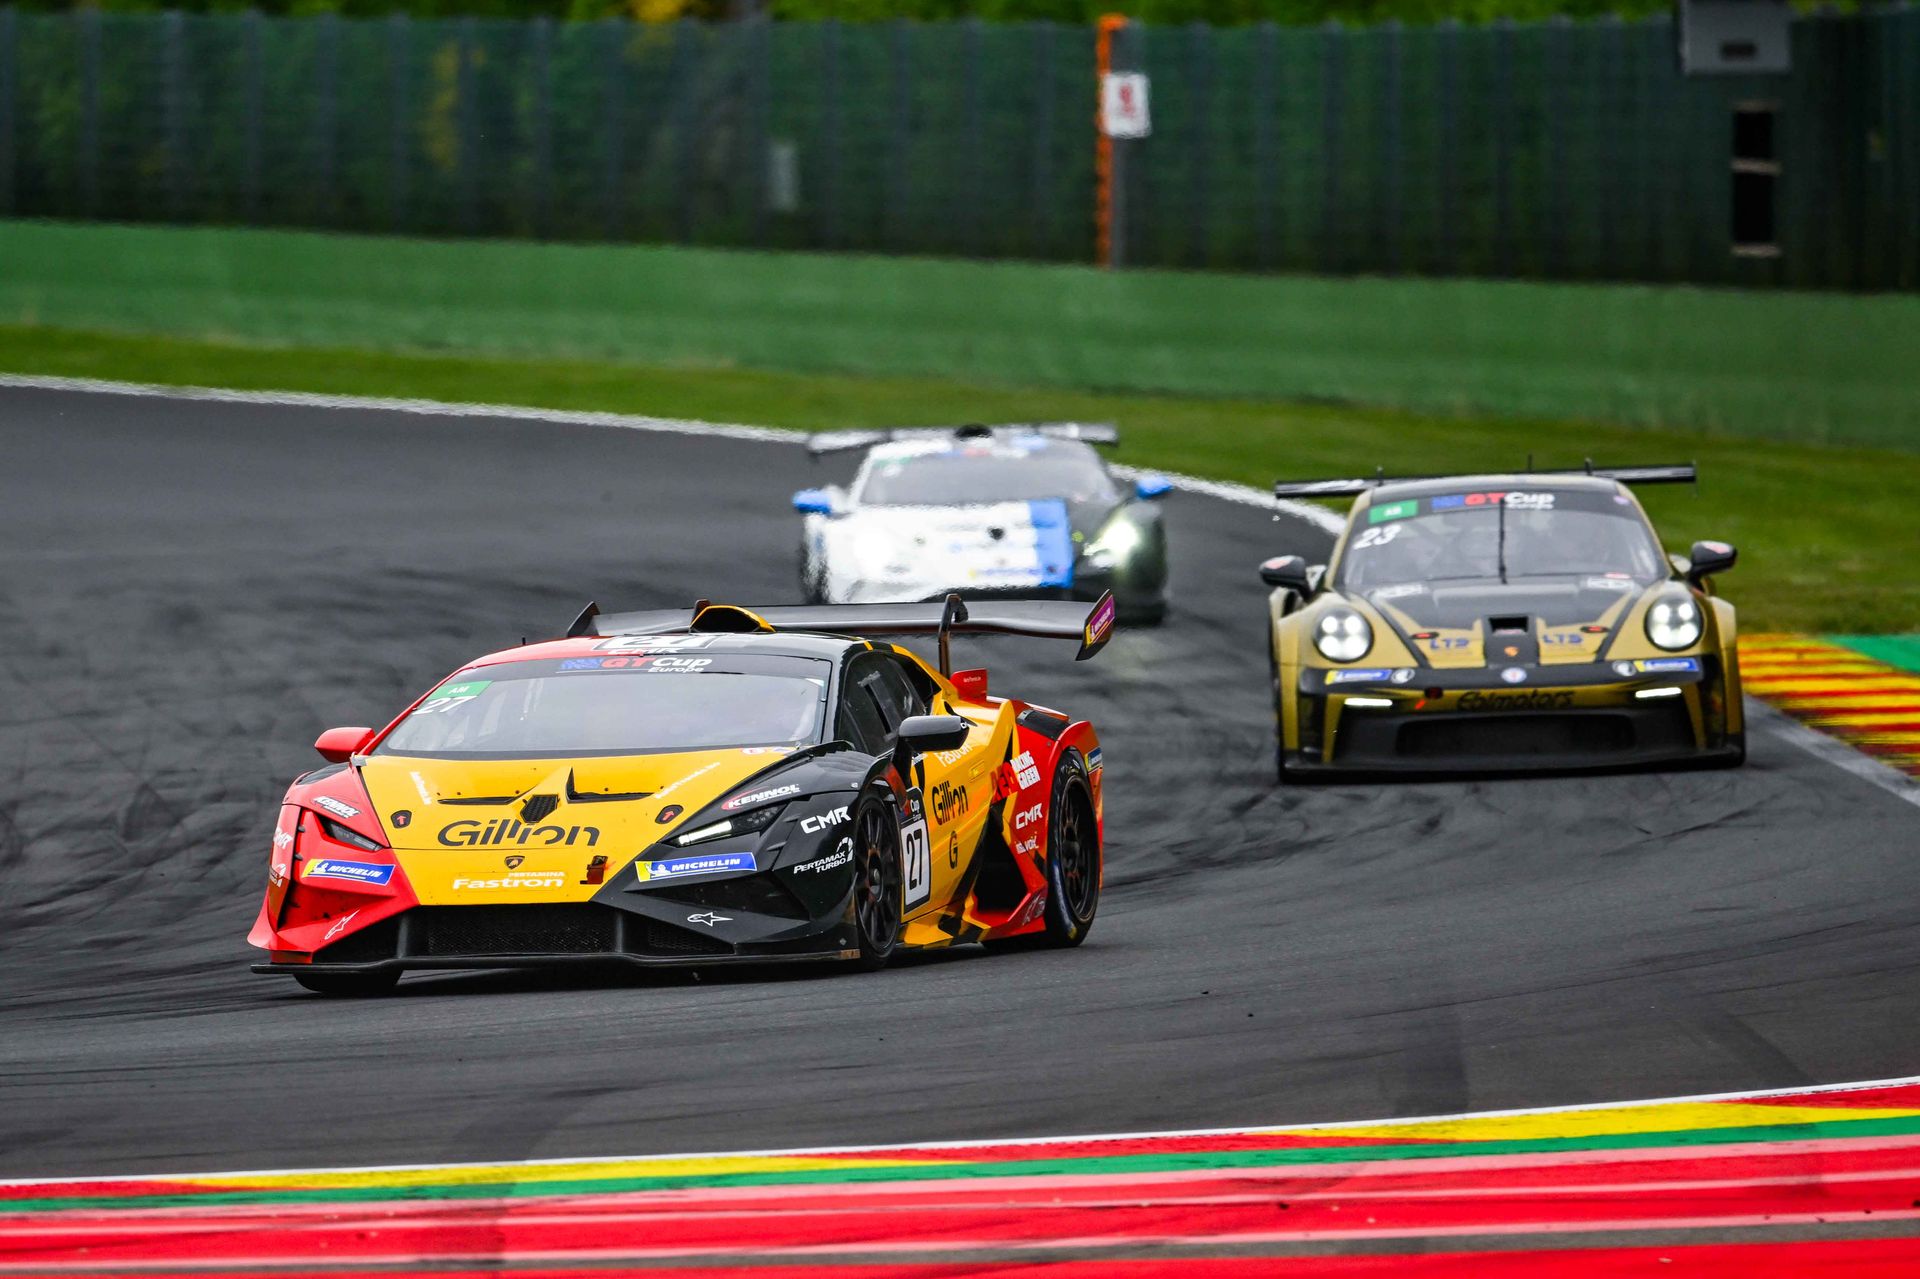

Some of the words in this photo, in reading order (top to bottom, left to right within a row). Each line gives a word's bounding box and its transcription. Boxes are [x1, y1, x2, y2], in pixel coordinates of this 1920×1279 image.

[1464, 493, 1505, 506] GT
[1504, 492, 1555, 505] Cup
[1353, 524, 1402, 550] 23
[602, 657, 656, 669] GT
[652, 657, 713, 671] Cup
[448, 686, 470, 695] AM
[412, 695, 478, 716] 27
[1010, 750, 1035, 771] RACING
[1016, 765, 1041, 791] GREEN
[728, 785, 801, 809] KENNOL
[931, 780, 970, 826] Gillion
[799, 805, 852, 834] CMR
[1015, 802, 1044, 830] CMR
[437, 818, 601, 847] Gillion
[906, 828, 923, 891] 27
[948, 830, 959, 870] G
[327, 865, 384, 878] MICHELIN
[671, 857, 741, 872] MICHELIN
[793, 850, 846, 875] PERTAMAX
[815, 857, 847, 874] TURBO
[451, 878, 565, 890] Fastron
